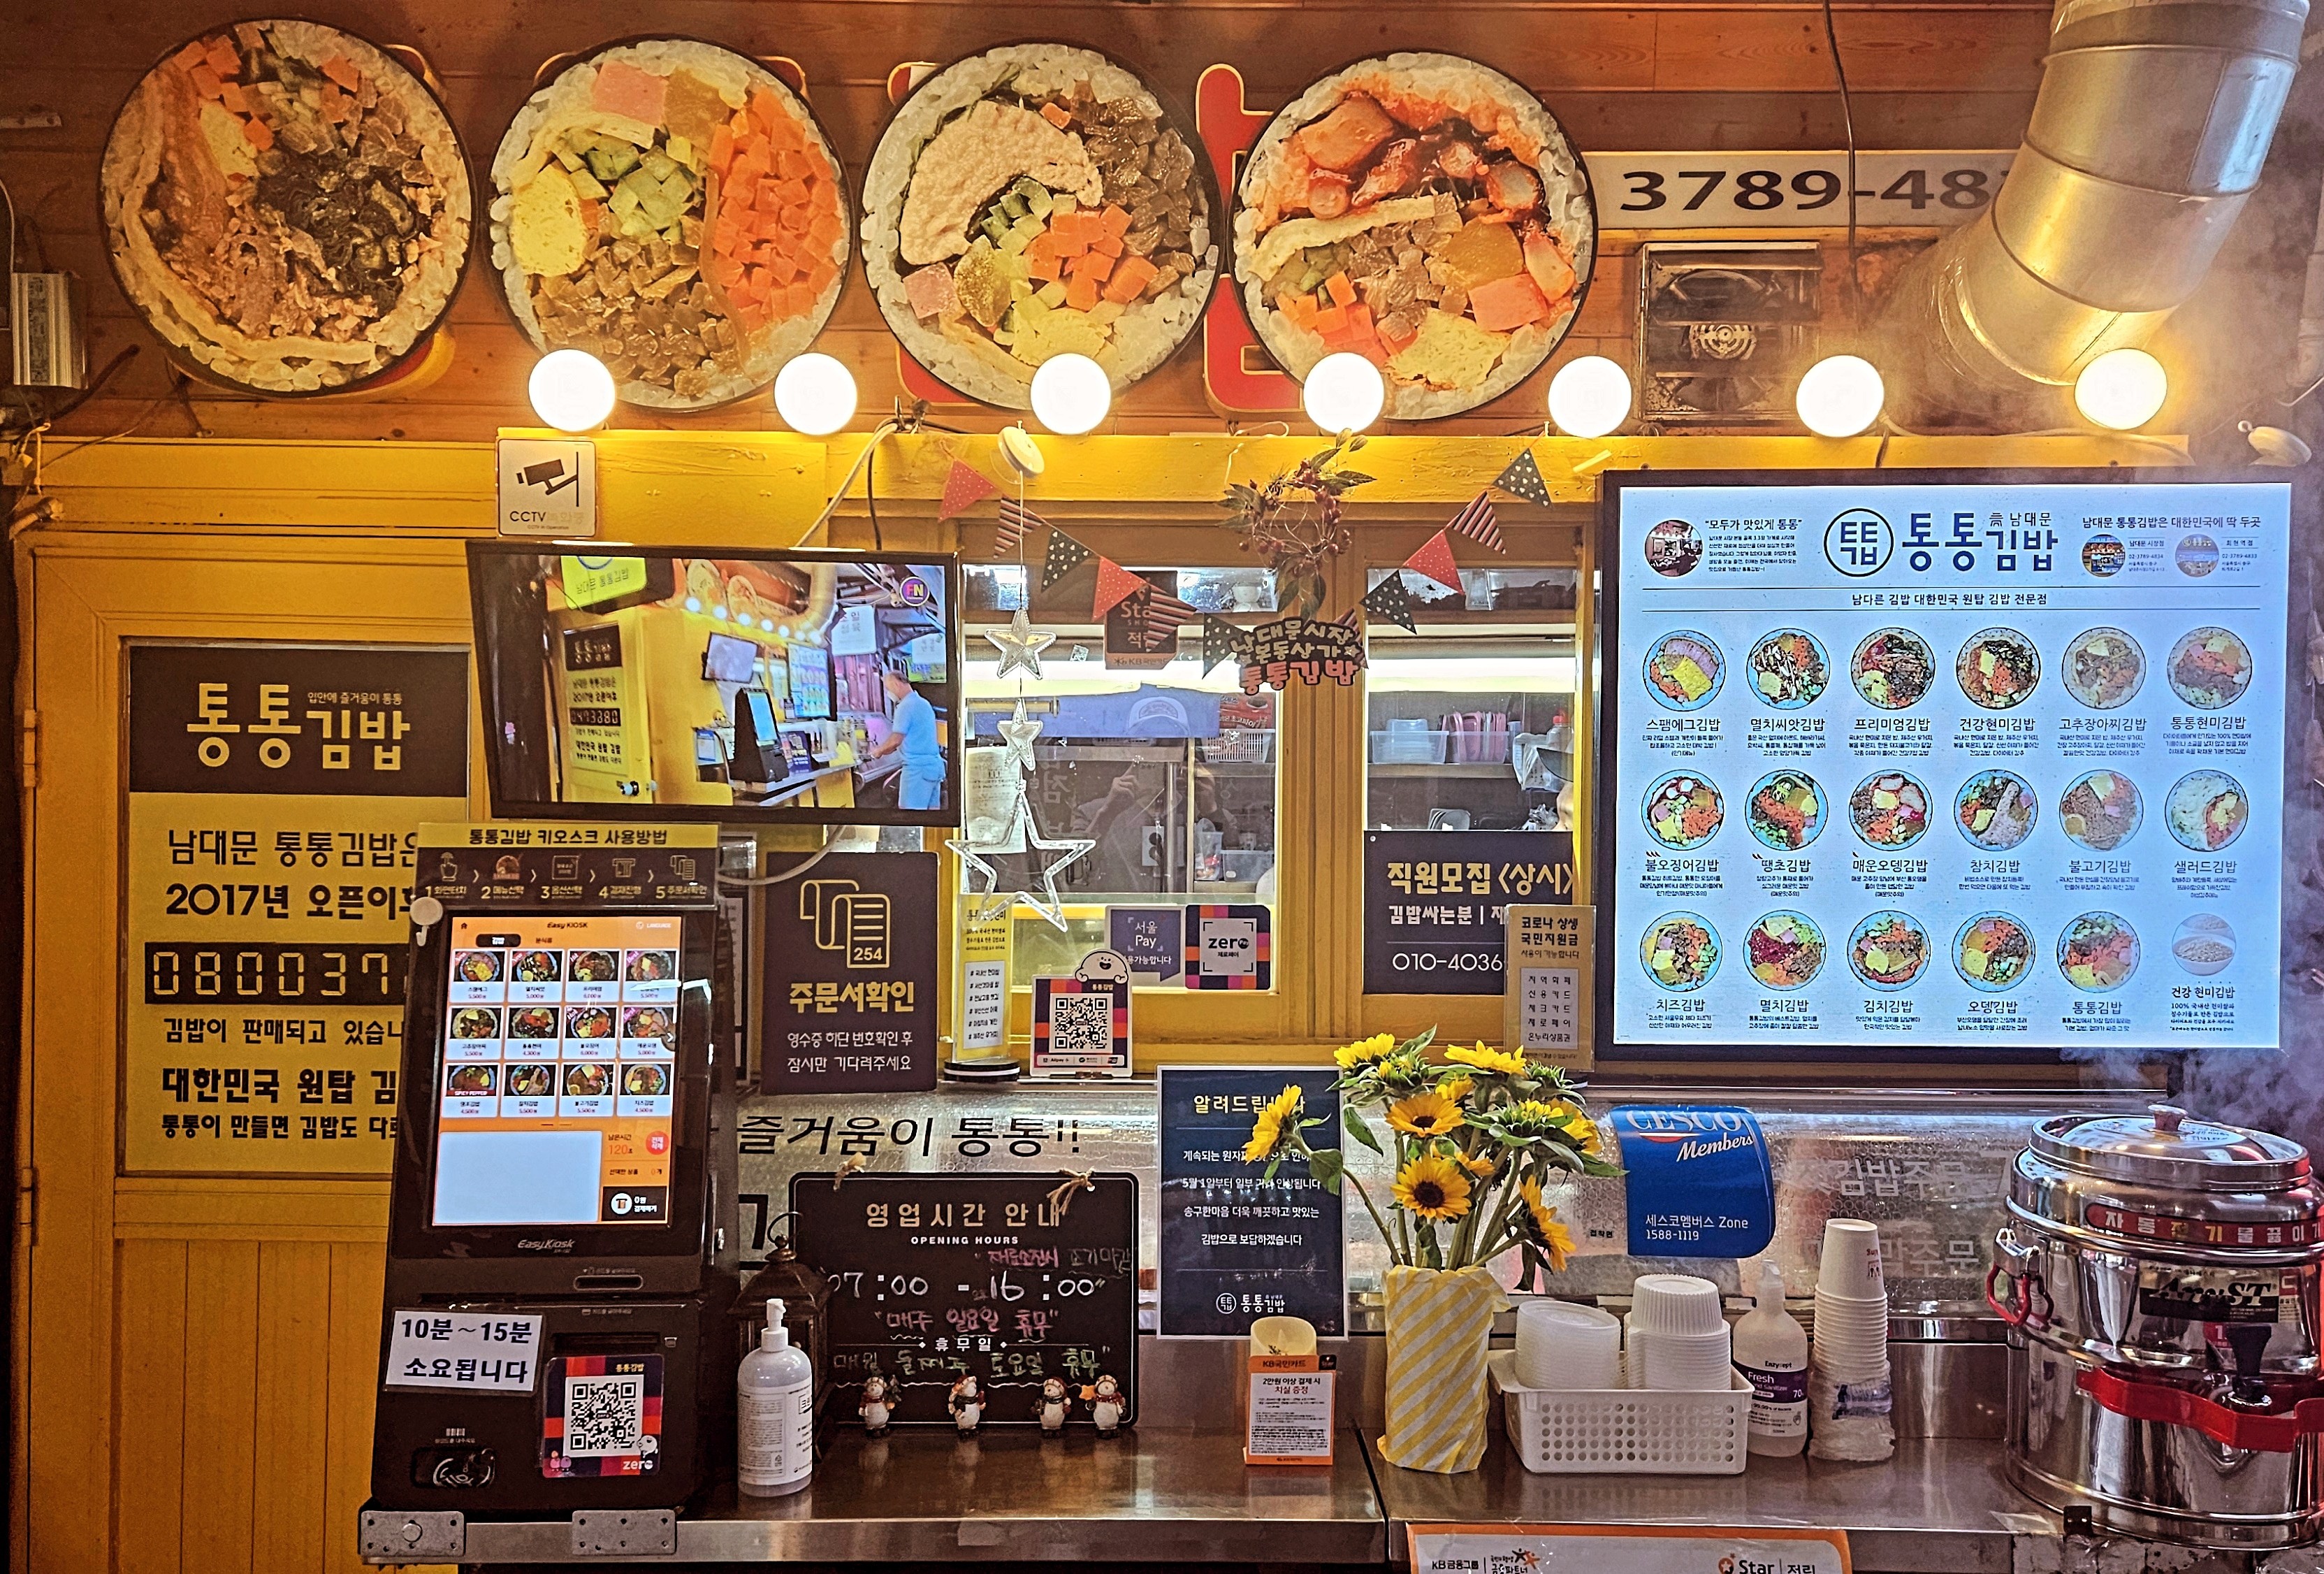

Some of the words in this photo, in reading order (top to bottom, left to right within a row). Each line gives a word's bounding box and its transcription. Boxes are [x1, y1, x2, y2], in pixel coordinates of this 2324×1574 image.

[1620, 170, 2007, 211] 3789-48
[510, 511, 546, 521] CCTV
[2010, 513, 2051, 526] 남대문
[2083, 517, 2113, 528] 남대문
[2116, 517, 2167, 528] 통통김밥은
[2171, 517, 2223, 528] 대한민국에
[2227, 517, 2237, 528] 딱
[2240, 517, 2261, 528] 두곳
[1744, 519, 1774, 530] 맛있게
[1903, 513, 2058, 571] 통통김밥
[1852, 594, 1884, 605] 남다른
[1889, 594, 1910, 605] 김밥
[1915, 594, 1958, 605] 대한민국
[1962, 594, 1984, 605] 원탑
[1989, 594, 2010, 605] 김밥
[2014, 594, 2047, 605] 전문점
[1120, 601, 1151, 618] Sta
[1230, 621, 1354, 652] 남대문시장
[1256, 641, 1341, 663] 본동상가
[1241, 660, 1360, 695] 통통김밥
[307, 691, 337, 704] 입안에
[340, 692, 379, 705] 즐거움이
[382, 693, 402, 705] 통통
[187, 682, 410, 770] 통통김밥
[1646, 719, 1720, 731] 스팸에그김밥
[1750, 719, 1825, 731] 멸치씨앗김밥
[1854, 719, 1930, 731] 프리미엄김밥
[1960, 719, 2035, 731] 건강현미김밥
[2058, 719, 2147, 731] 고추장아찌김밥
[2170, 716, 2246, 730] 통통현미김밥
[469, 830, 531, 844] 통통김밥
[537, 830, 599, 844] 키오스크
[604, 830, 668, 844] 사용방법
[168, 830, 258, 865] 남대문
[1646, 860, 1719, 872] 불오징어김밥
[1762, 860, 1810, 872] 땡초김밥
[1853, 860, 1928, 872] 매운오뎅김밥
[1970, 860, 2020, 872] 참치김밥
[2068, 860, 2131, 873] 불고기김밥
[2174, 860, 2237, 873] 샐러드김밥
[1387, 862, 1490, 895] 직원모집
[481, 887, 491, 899] 2
[541, 887, 550, 899] 3
[599, 887, 608, 899] 4
[655, 887, 665, 899] 5
[166, 883, 289, 919] 2017년
[1389, 905, 1472, 925] 김밥싸는분
[1135, 920, 1157, 934] 서울
[1522, 917, 1553, 930] 코로나
[1557, 918, 1578, 930] 상생
[1135, 935, 1157, 948] Pay
[1208, 938, 1249, 949] zero
[1521, 933, 1578, 946] 국민지원금
[854, 948, 883, 960] 254
[1122, 955, 1172, 965] 용가능합니다
[1393, 953, 1504, 971] 010-4036
[790, 982, 914, 1013] 주문서확인
[2172, 986, 2191, 998] 건강
[2195, 986, 2235, 998] 현미김밥
[1657, 999, 1705, 1011] 치즈김밥
[1760, 999, 1808, 1012] 멸치김밥
[1864, 1000, 1913, 1013] 김치김밥
[1968, 1001, 2017, 1013] 오뎅김밥
[2072, 1002, 2122, 1014] 통통김밥
[164, 1018, 226, 1043] 김밥이
[242, 1019, 326, 1044] 판매되고
[344, 1020, 405, 1046] 있습니
[1528, 1033, 1570, 1042] 온누리상품권
[787, 1032, 822, 1048] 영수증
[826, 1032, 849, 1047] 하단
[852, 1032, 898, 1046] 번호확인
[901, 1032, 913, 1046] 후
[787, 1057, 827, 1072] 잠시만
[834, 1056, 911, 1071] 기다려주세요
[162, 1068, 279, 1103] 대한민국
[298, 1069, 356, 1104] 원탑
[371, 1071, 397, 1104] 김
[1194, 1095, 1305, 1113] 알려드립
[161, 1115, 221, 1139] 통통이
[231, 1115, 289, 1139] 만들면
[300, 1115, 358, 1139] 김밥도
[1625, 1110, 1743, 1132] CESCO
[736, 1116, 933, 1157] 즐거움이
[1676, 1132, 1754, 1162] Members
[1184, 1150, 1219, 1162] 계속되는
[1235, 1178, 1253, 1189] 일부
[866, 1203, 986, 1227] 영업시간
[1005, 1203, 1060, 1227] 안내
[1184, 1206, 1229, 1218] 송구한마음
[1233, 1206, 1249, 1218] 더욱
[1253, 1206, 1289, 1218] 깨끗하고
[1293, 1206, 1319, 1218] 맛있는
[1645, 1215, 1715, 1228] 세스코멤버스
[1719, 1216, 1748, 1229] Zone
[911, 1236, 969, 1245] OPENING
[975, 1236, 1019, 1245] HOURS
[1201, 1234, 1237, 1246] 김밥으로
[1240, 1234, 1302, 1246] 보답하겠습니다
[1646, 1229, 1699, 1241] 1588-1119
[1241, 1294, 1285, 1313] 통통김밥
[935, 1338, 992, 1352] 휴무일
[404, 1358, 528, 1384] 소요됩니다
[1748, 1371, 1774, 1384] Fresh
[1275, 1386, 1290, 1394] 치실
[1293, 1386, 1309, 1394] 증정
[1739, 1560, 1774, 1574] Star
